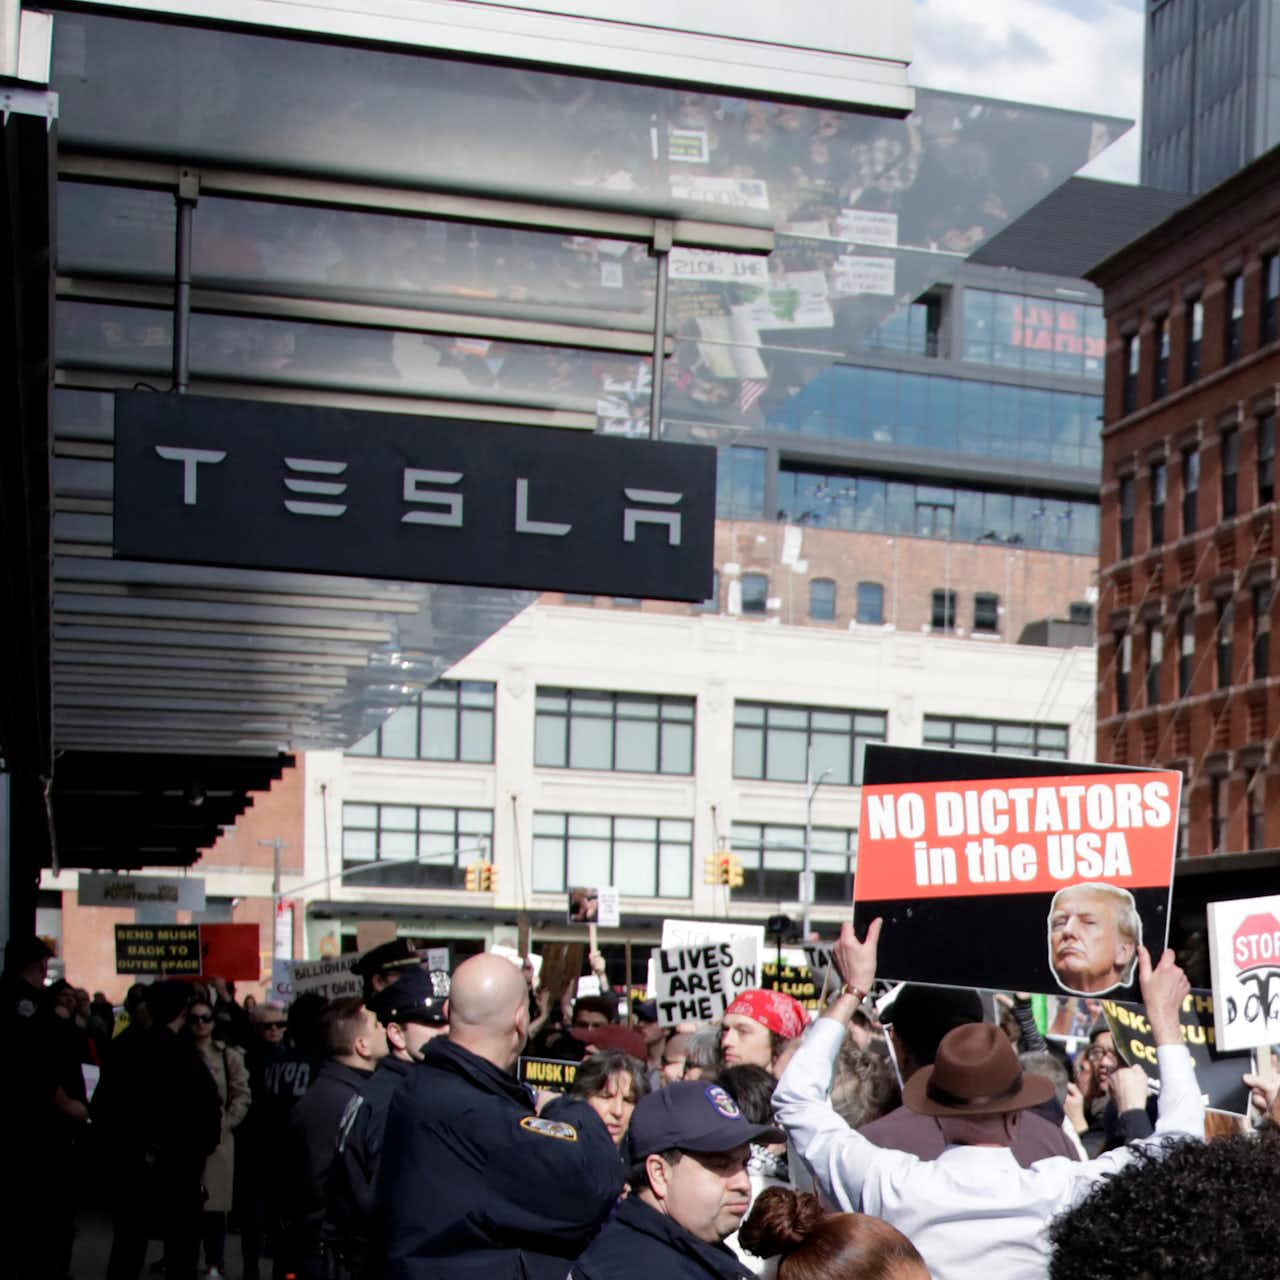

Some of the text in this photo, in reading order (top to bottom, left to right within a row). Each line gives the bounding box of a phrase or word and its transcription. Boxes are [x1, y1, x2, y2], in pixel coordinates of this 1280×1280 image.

[155, 445, 683, 546] TESLA
[867, 781, 1171, 840] NO DICTATORS
[914, 832, 1133, 886] in the USA
[117, 929, 198, 941] SEND MUSK
[127, 944, 189, 956] BACK TO
[661, 943, 734, 974] LIVES
[117, 959, 199, 970] OUTER SPACE
[669, 971, 724, 997] ARE
[731, 966, 758, 987] ON
[660, 1000, 714, 1022] THE
[526, 1062, 562, 1083] MUSK
